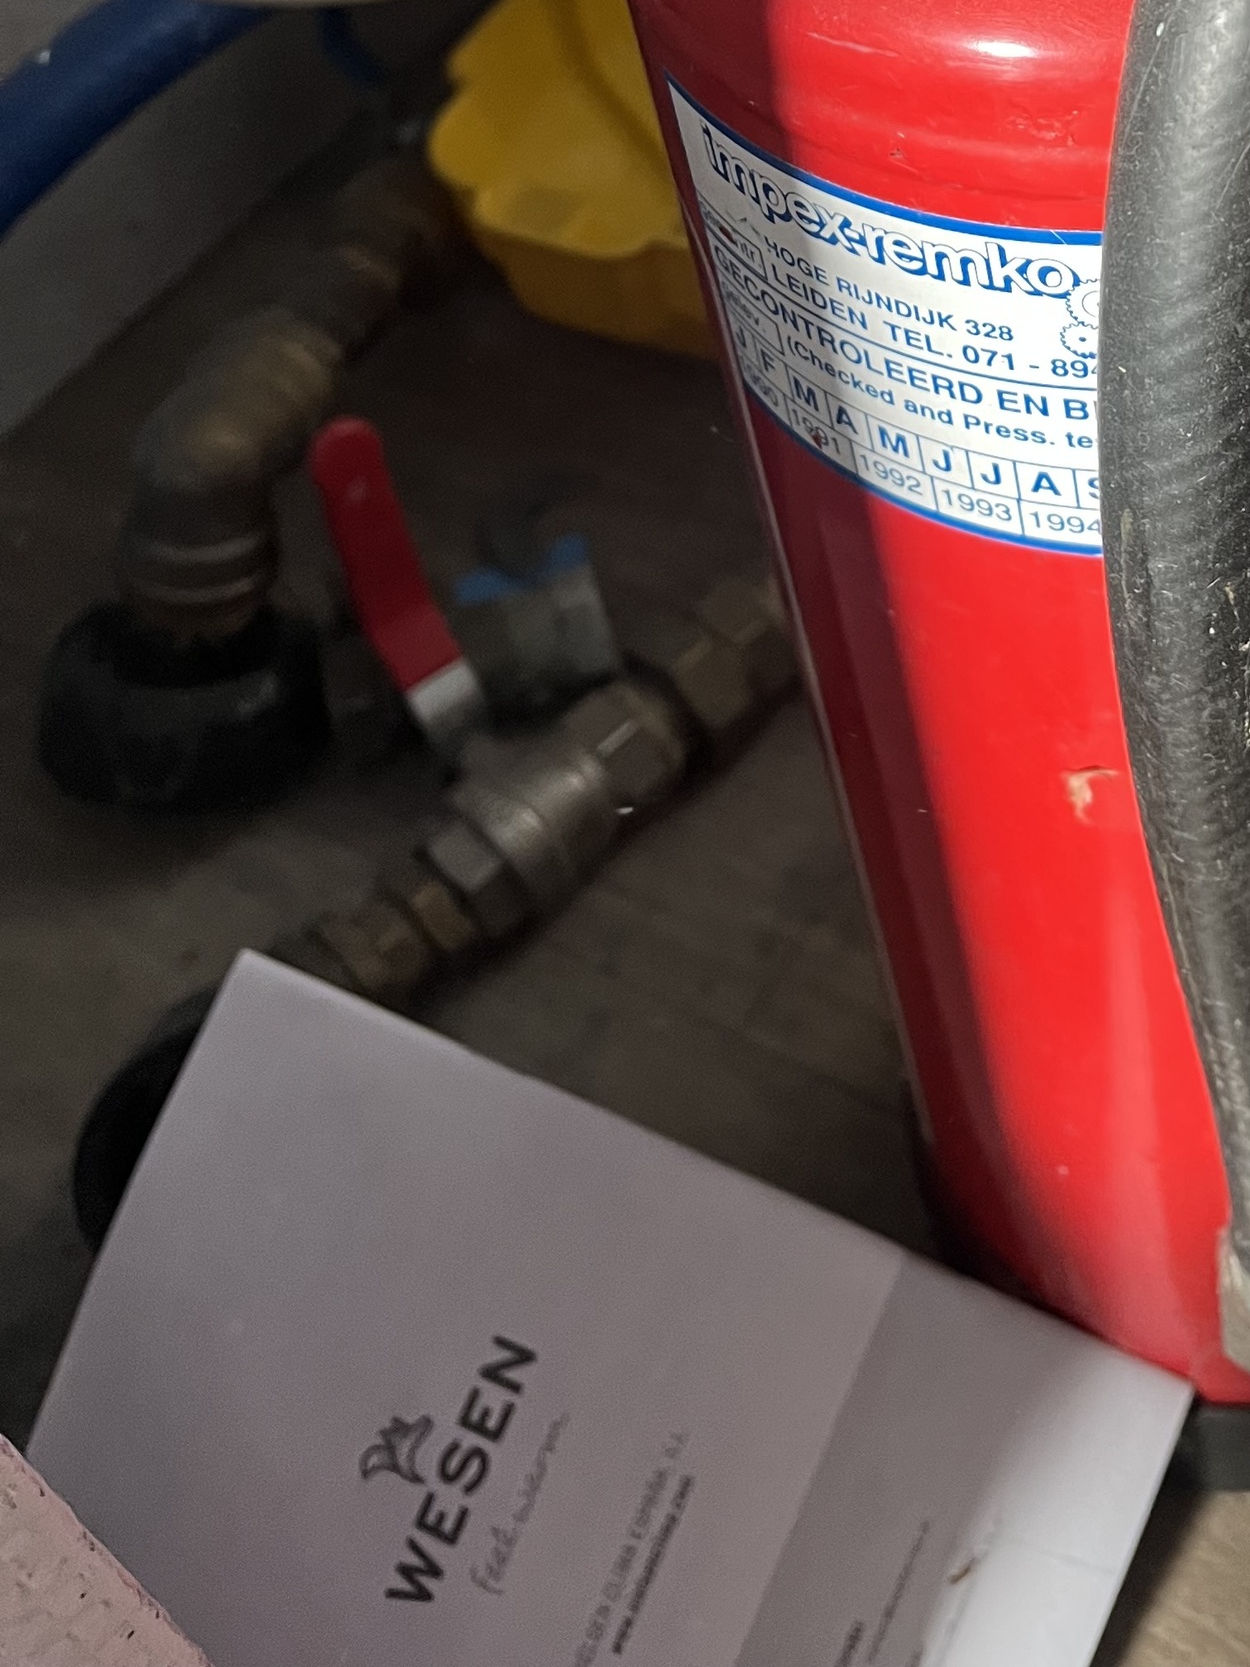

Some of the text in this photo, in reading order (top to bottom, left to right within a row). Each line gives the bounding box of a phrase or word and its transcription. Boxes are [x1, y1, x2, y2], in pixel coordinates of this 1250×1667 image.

[700, 121, 1081, 300] impex-remko
[714, 245, 984, 406] GECONTROLEERD
[996, 389, 1050, 417] EN
[1063, 398, 1101, 421] B
[764, 235, 1014, 342] HOGE RIJNDIJK 328
[771, 263, 868, 330] LEIDEN
[883, 320, 953, 359] TEL.
[962, 344, 1015, 371] 071
[760, 348, 776, 372] F
[792, 376, 819, 412] M
[836, 405, 859, 435] A
[877, 424, 910, 459] M
[932, 449, 952, 473] J
[980, 462, 1001, 485] J
[1031, 471, 1062, 497] A
[787, 335, 1099, 450] (Checked and Press. te
[859, 454, 924, 497] 1992
[941, 489, 1013, 522] 1993
[384, 1334, 538, 1603] WESEN
